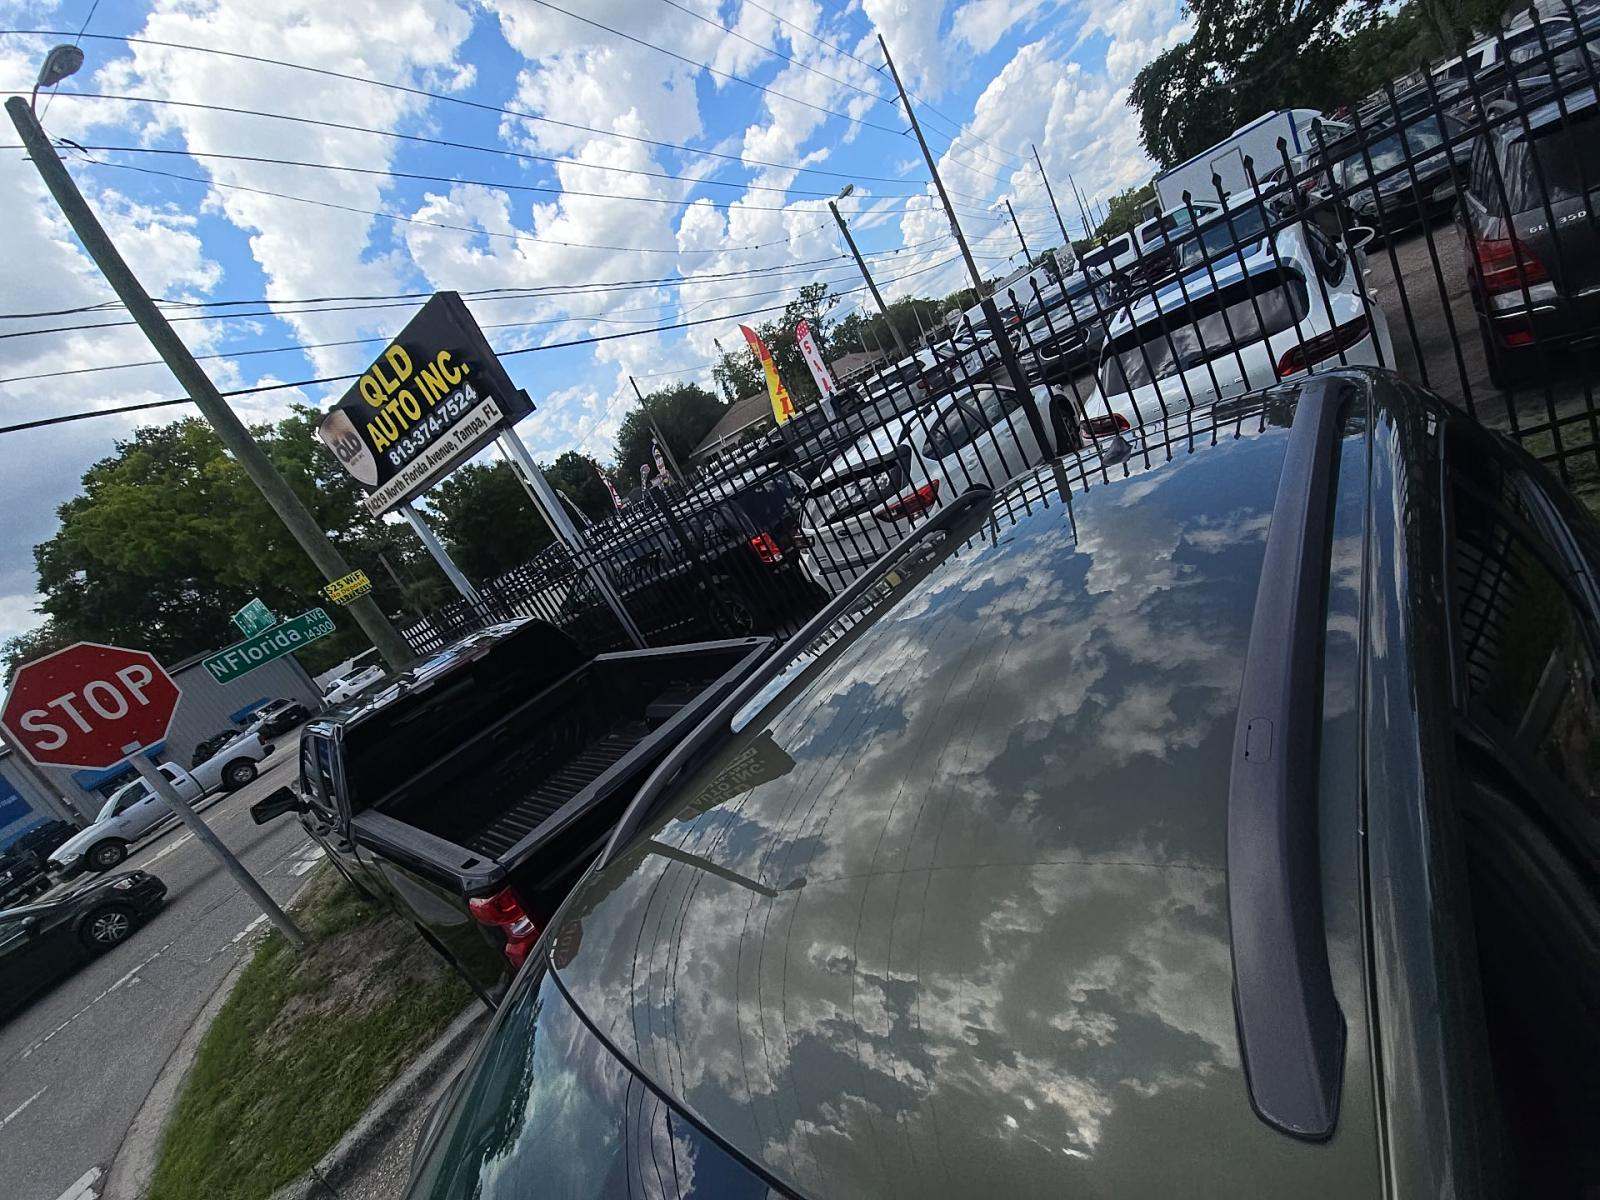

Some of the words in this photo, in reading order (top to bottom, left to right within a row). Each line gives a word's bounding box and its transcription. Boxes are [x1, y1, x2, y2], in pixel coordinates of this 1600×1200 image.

[1530, 221, 1550, 234] GL
[359, 344, 413, 408] QLD
[366, 389, 422, 453] AUTO
[414, 350, 470, 407] INC.
[383, 479, 406, 500] North
[401, 460, 429, 487] Florida
[425, 439, 459, 467] Avenue,
[453, 416, 488, 443] Tampa,
[481, 403, 499, 421] FL
[389, 382, 477, 466] 813-374-7524
[303, 620, 333, 640] 14300
[304, 608, 326, 625] AVE
[209, 660, 226, 677] N
[223, 627, 301, 671] Florida
[19, 664, 153, 751] STOP
